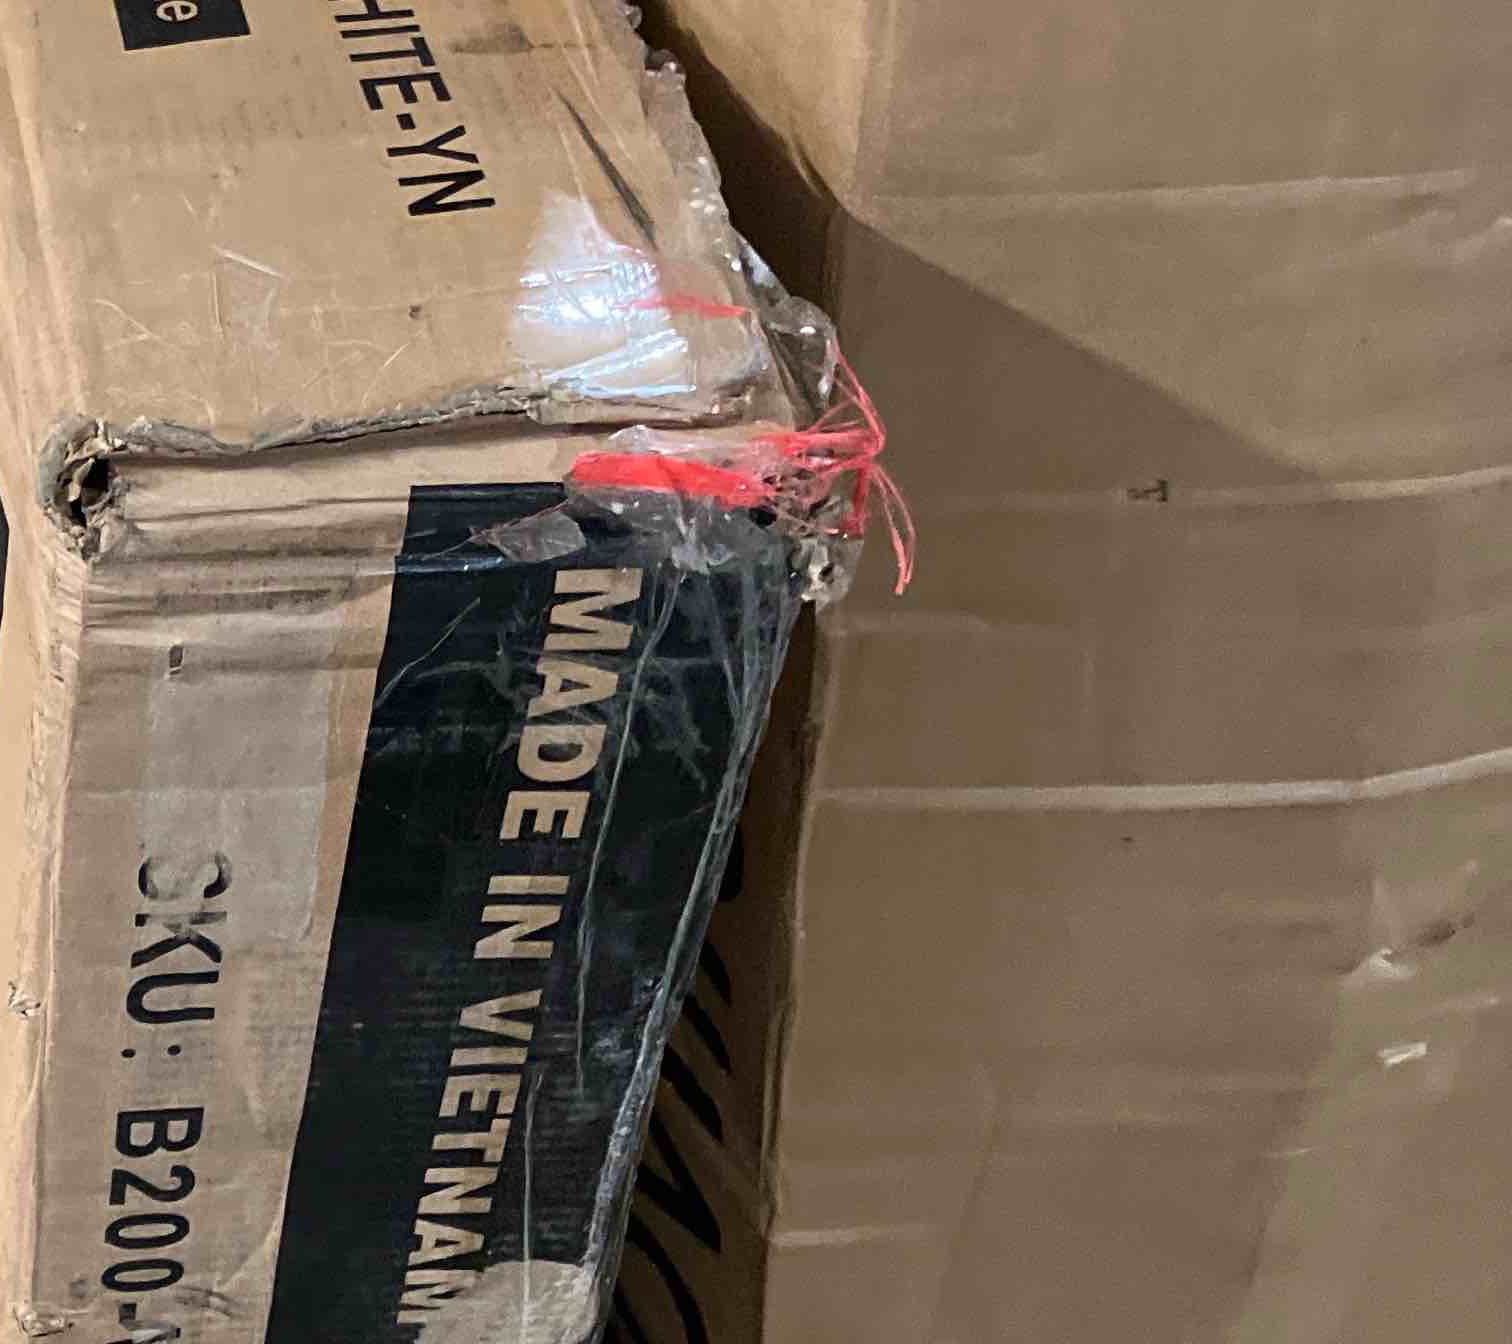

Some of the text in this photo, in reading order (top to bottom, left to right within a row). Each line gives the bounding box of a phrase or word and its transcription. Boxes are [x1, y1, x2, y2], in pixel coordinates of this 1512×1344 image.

[501, 565, 643, 842] MADE
[120, 851, 233, 1061] SKU:
[473, 874, 572, 960] IN
